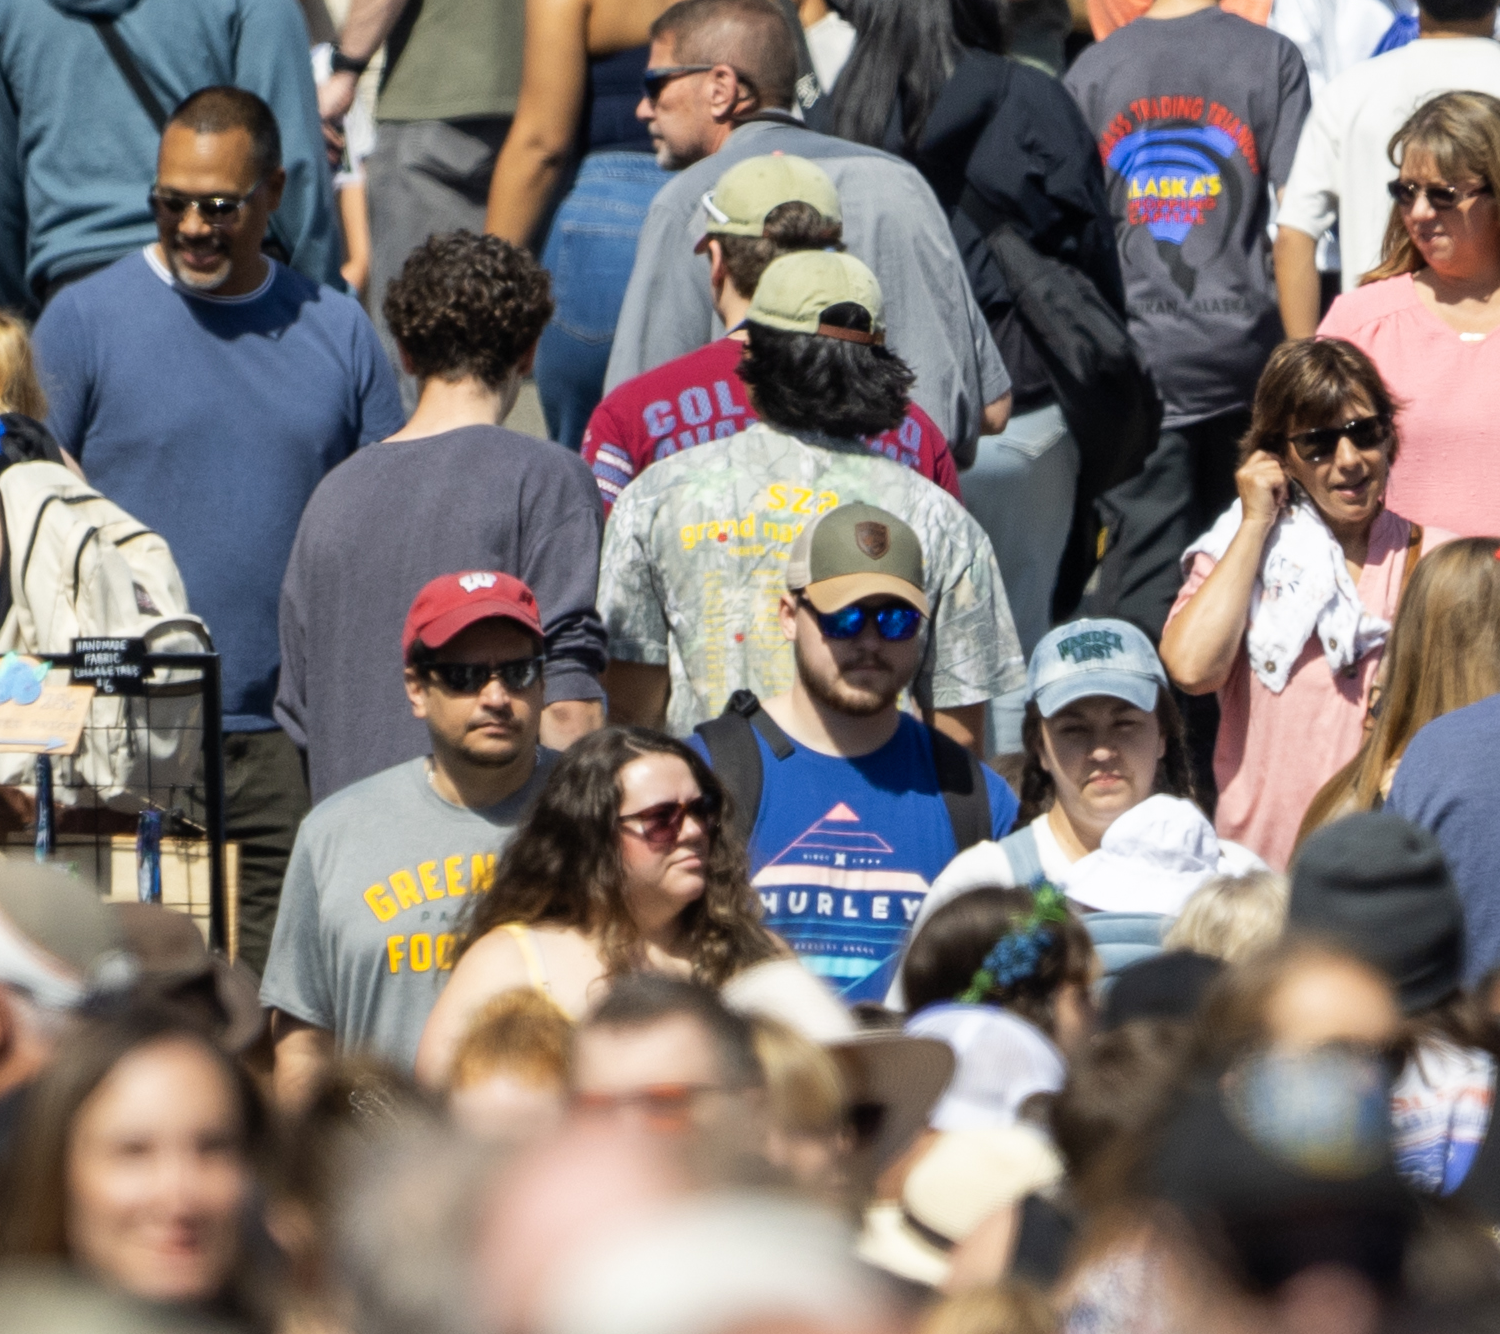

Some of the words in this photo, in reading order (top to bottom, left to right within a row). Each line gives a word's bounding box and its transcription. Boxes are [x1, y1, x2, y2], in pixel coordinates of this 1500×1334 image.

[1129, 95, 1205, 122] TRADING
[1127, 199, 1217, 213] HOPPING
[680, 512, 756, 550] grand
[84, 652, 123, 666] FABRIC
[1074, 644, 1111, 664] LUST
[364, 854, 496, 922] GREEN
[759, 890, 922, 921] HURLEY
